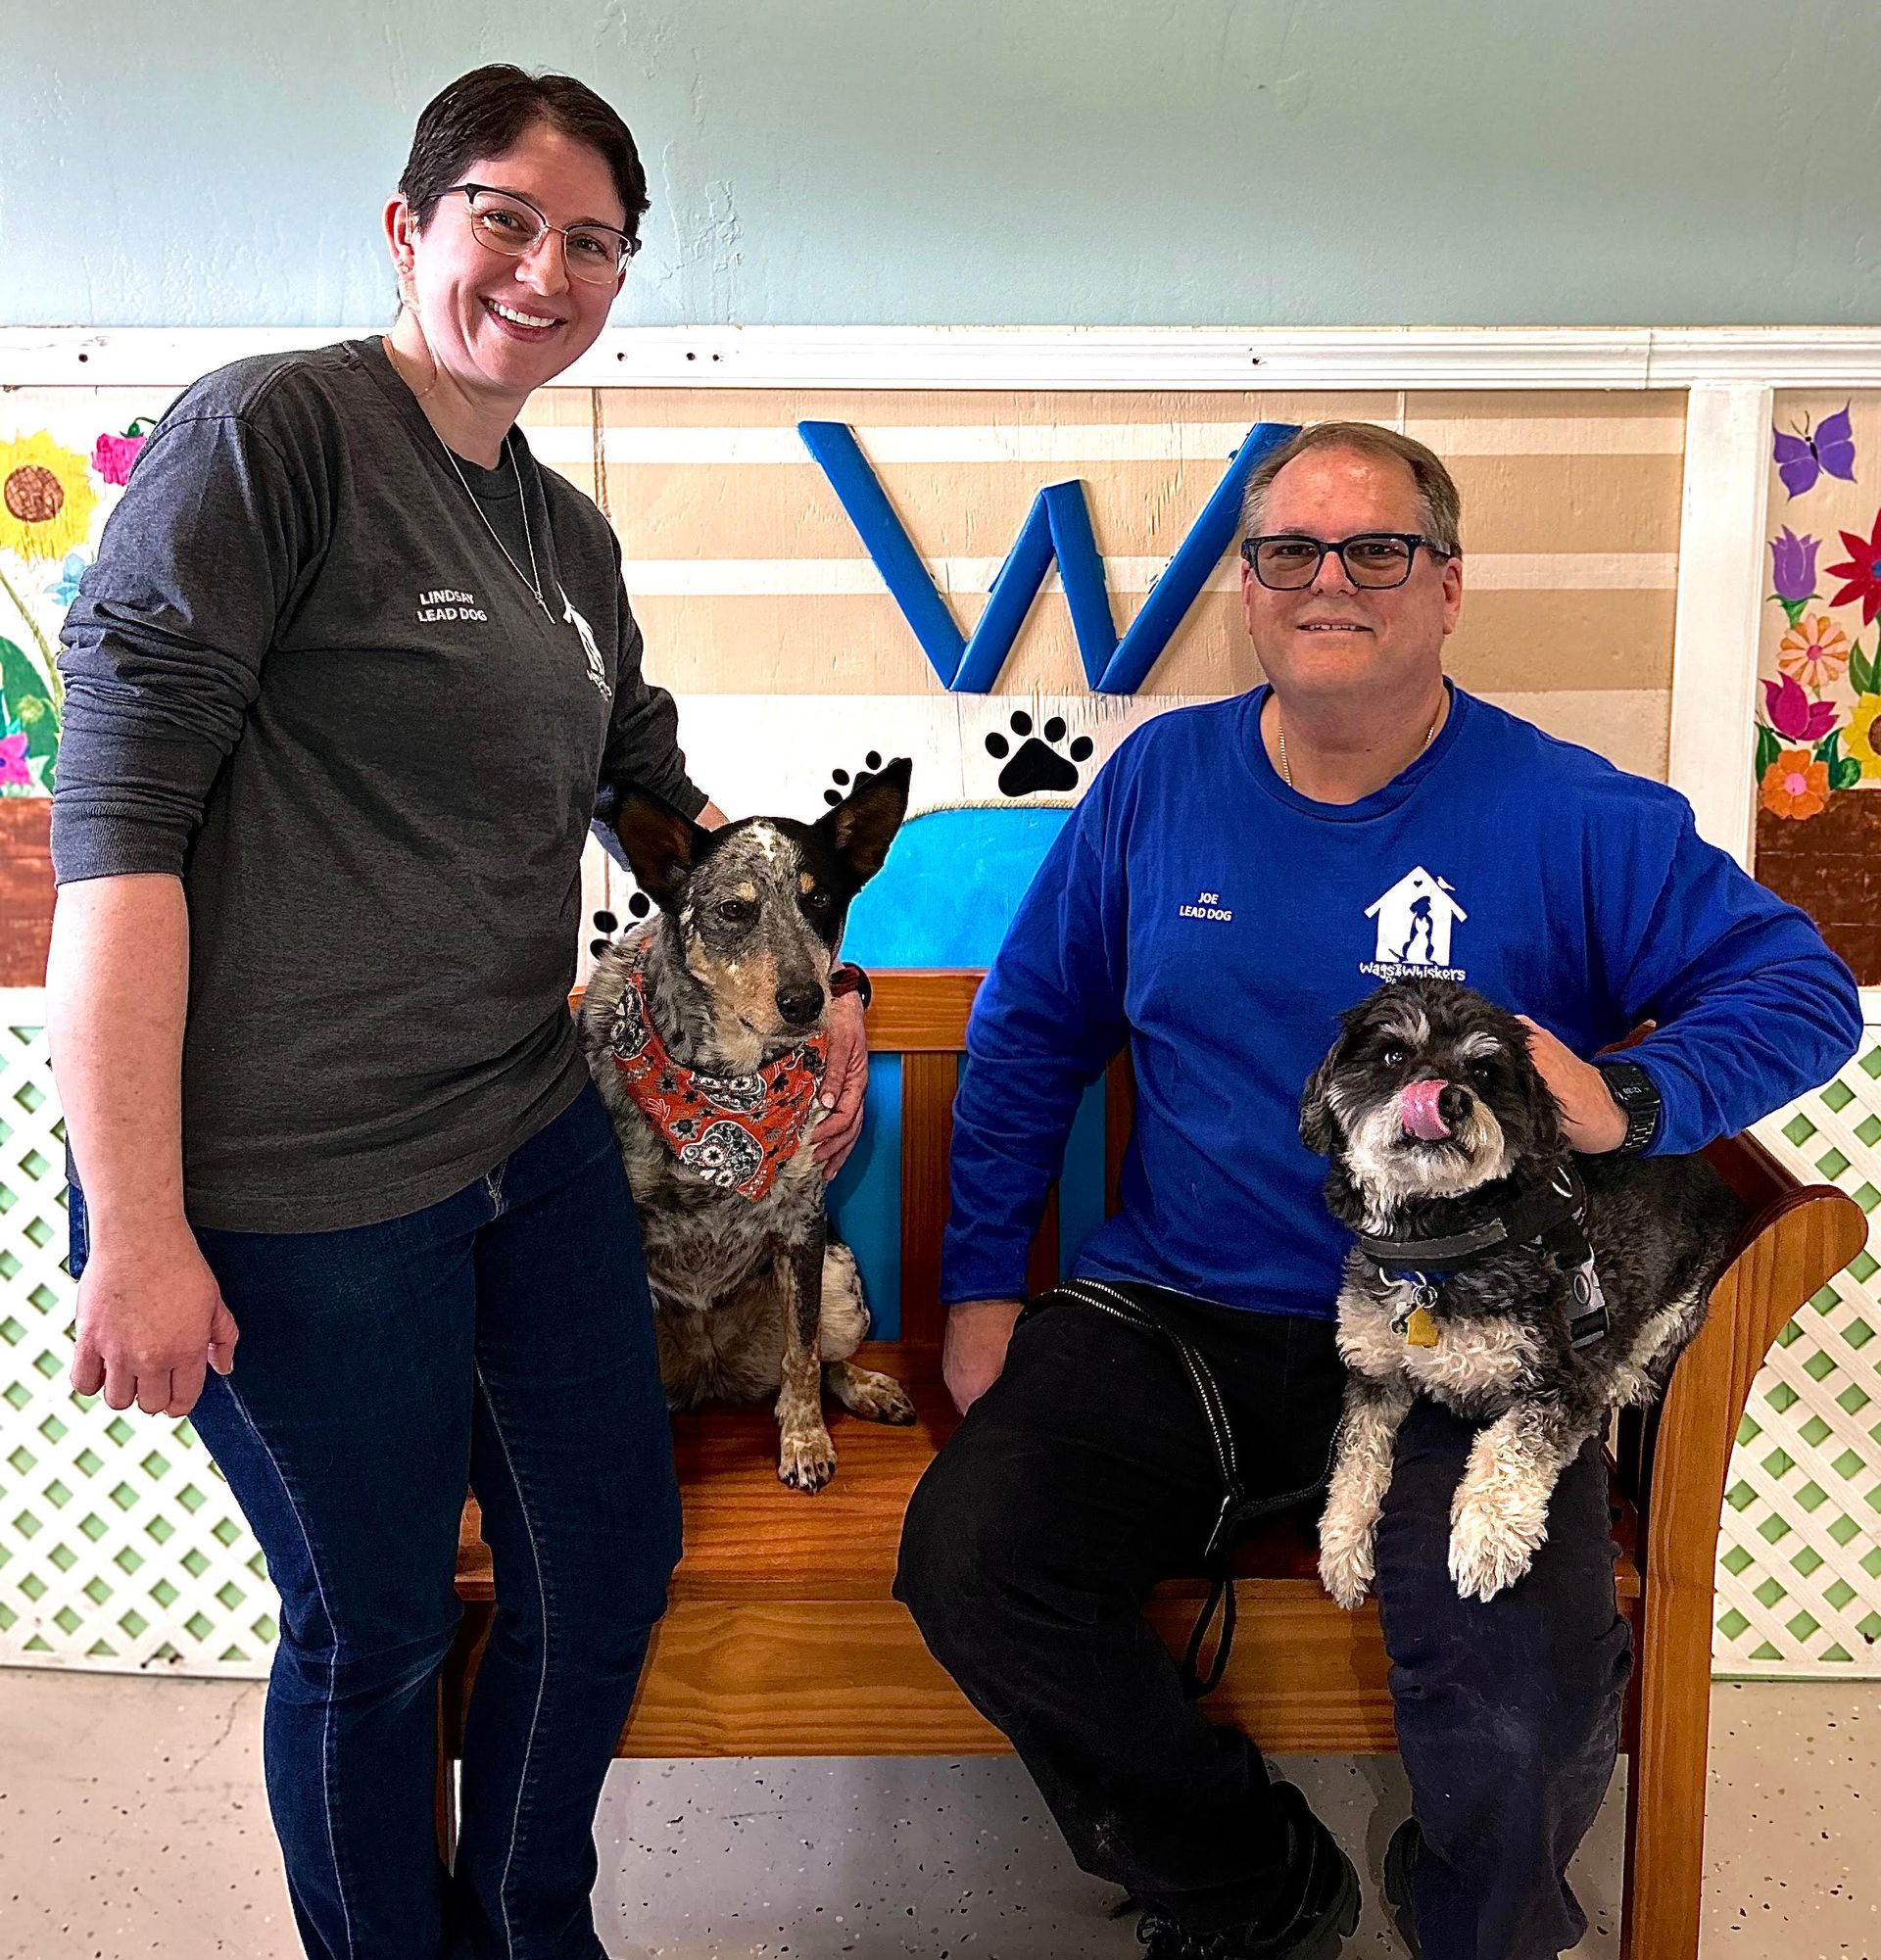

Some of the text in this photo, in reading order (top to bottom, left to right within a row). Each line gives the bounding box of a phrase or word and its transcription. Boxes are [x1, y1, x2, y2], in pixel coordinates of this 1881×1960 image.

[797, 420, 1302, 693] W
[419, 589, 474, 605] LINDSAY
[416, 606, 488, 622] LEAD DOG
[1197, 892, 1219, 905] JOE
[1179, 905, 1232, 922] LEAD DOG
